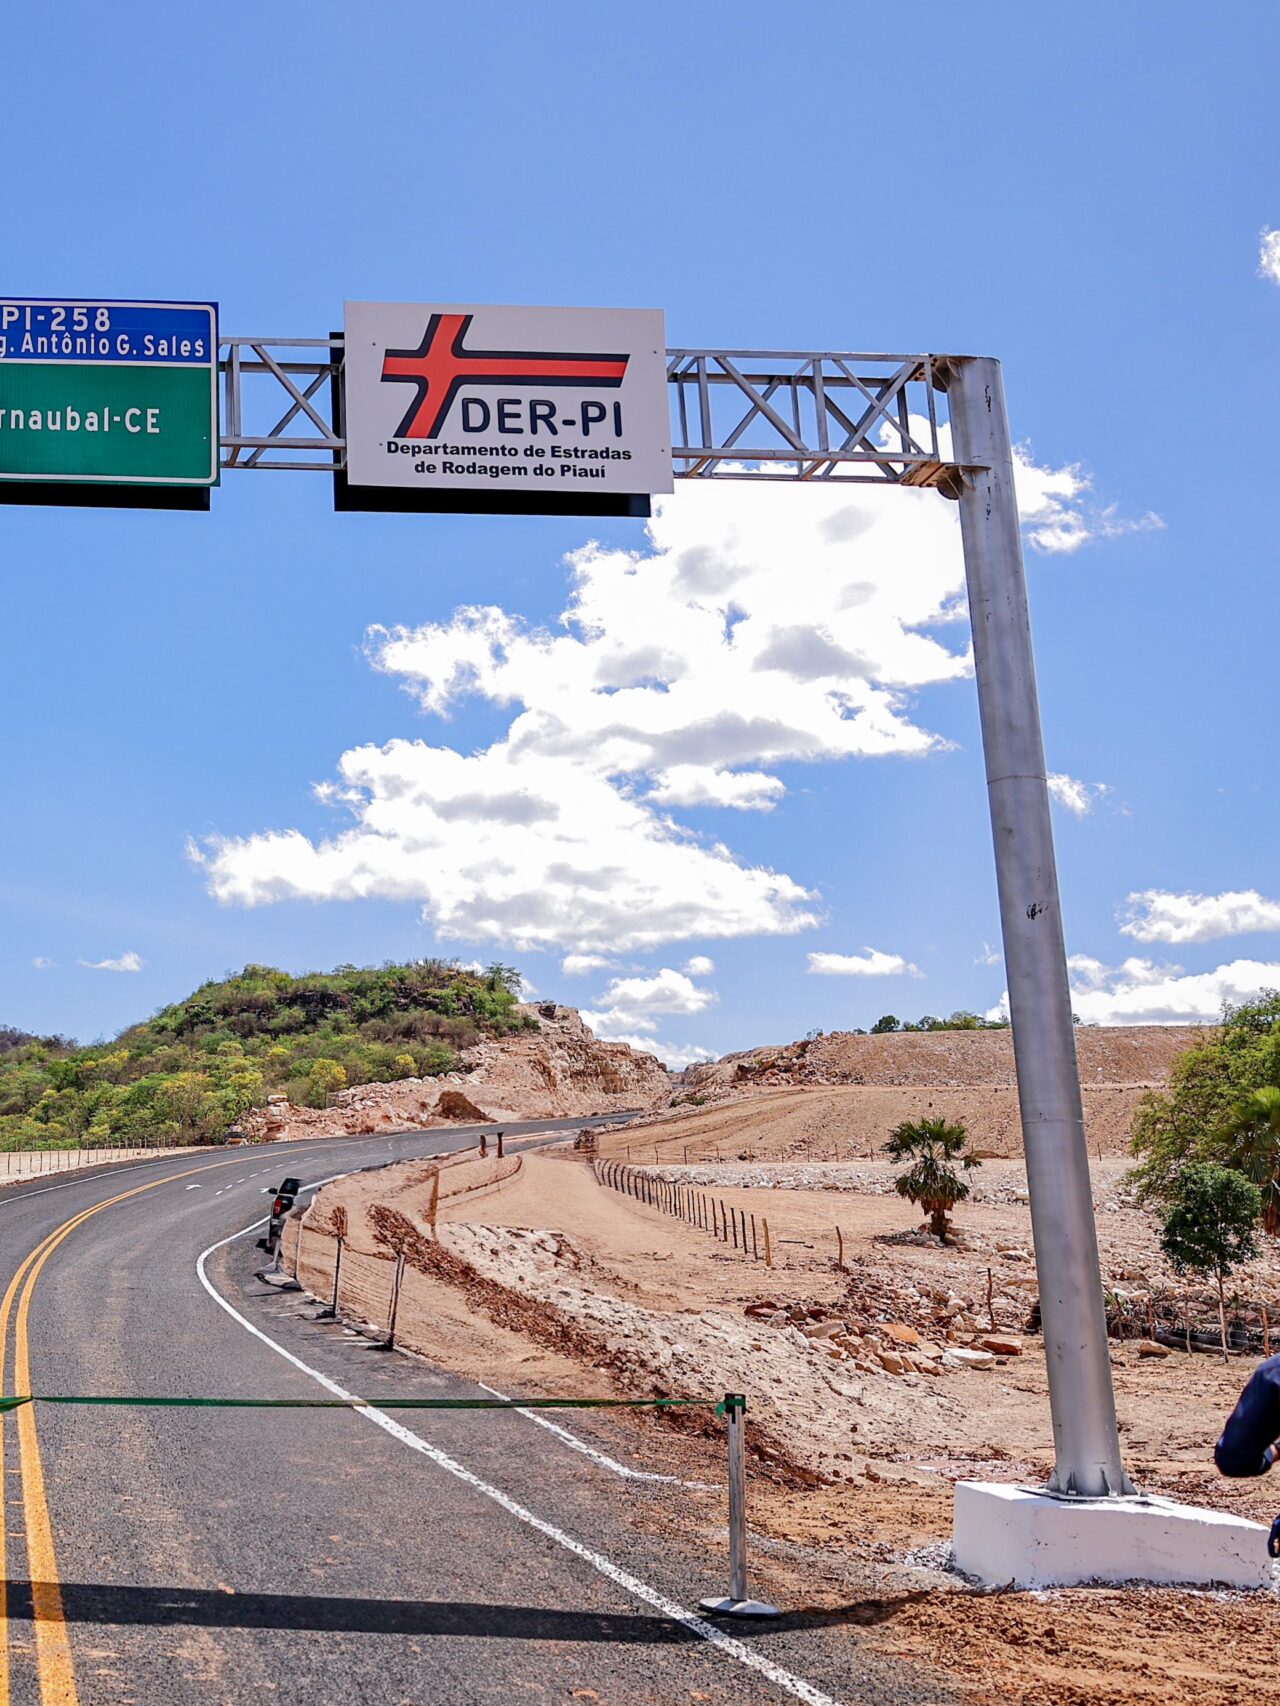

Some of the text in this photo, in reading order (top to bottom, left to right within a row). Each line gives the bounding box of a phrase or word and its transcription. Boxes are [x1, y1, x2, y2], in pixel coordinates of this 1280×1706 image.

[1, 306, 111, 332] PI-258
[21, 332, 110, 355] Antônio
[116, 334, 137, 355] G.
[143, 335, 204, 357] Sales
[461, 397, 623, 437] DER-PI
[386, 441, 632, 461] Departamento de Estradas
[414, 461, 606, 478] de Rodagem do Piauí
